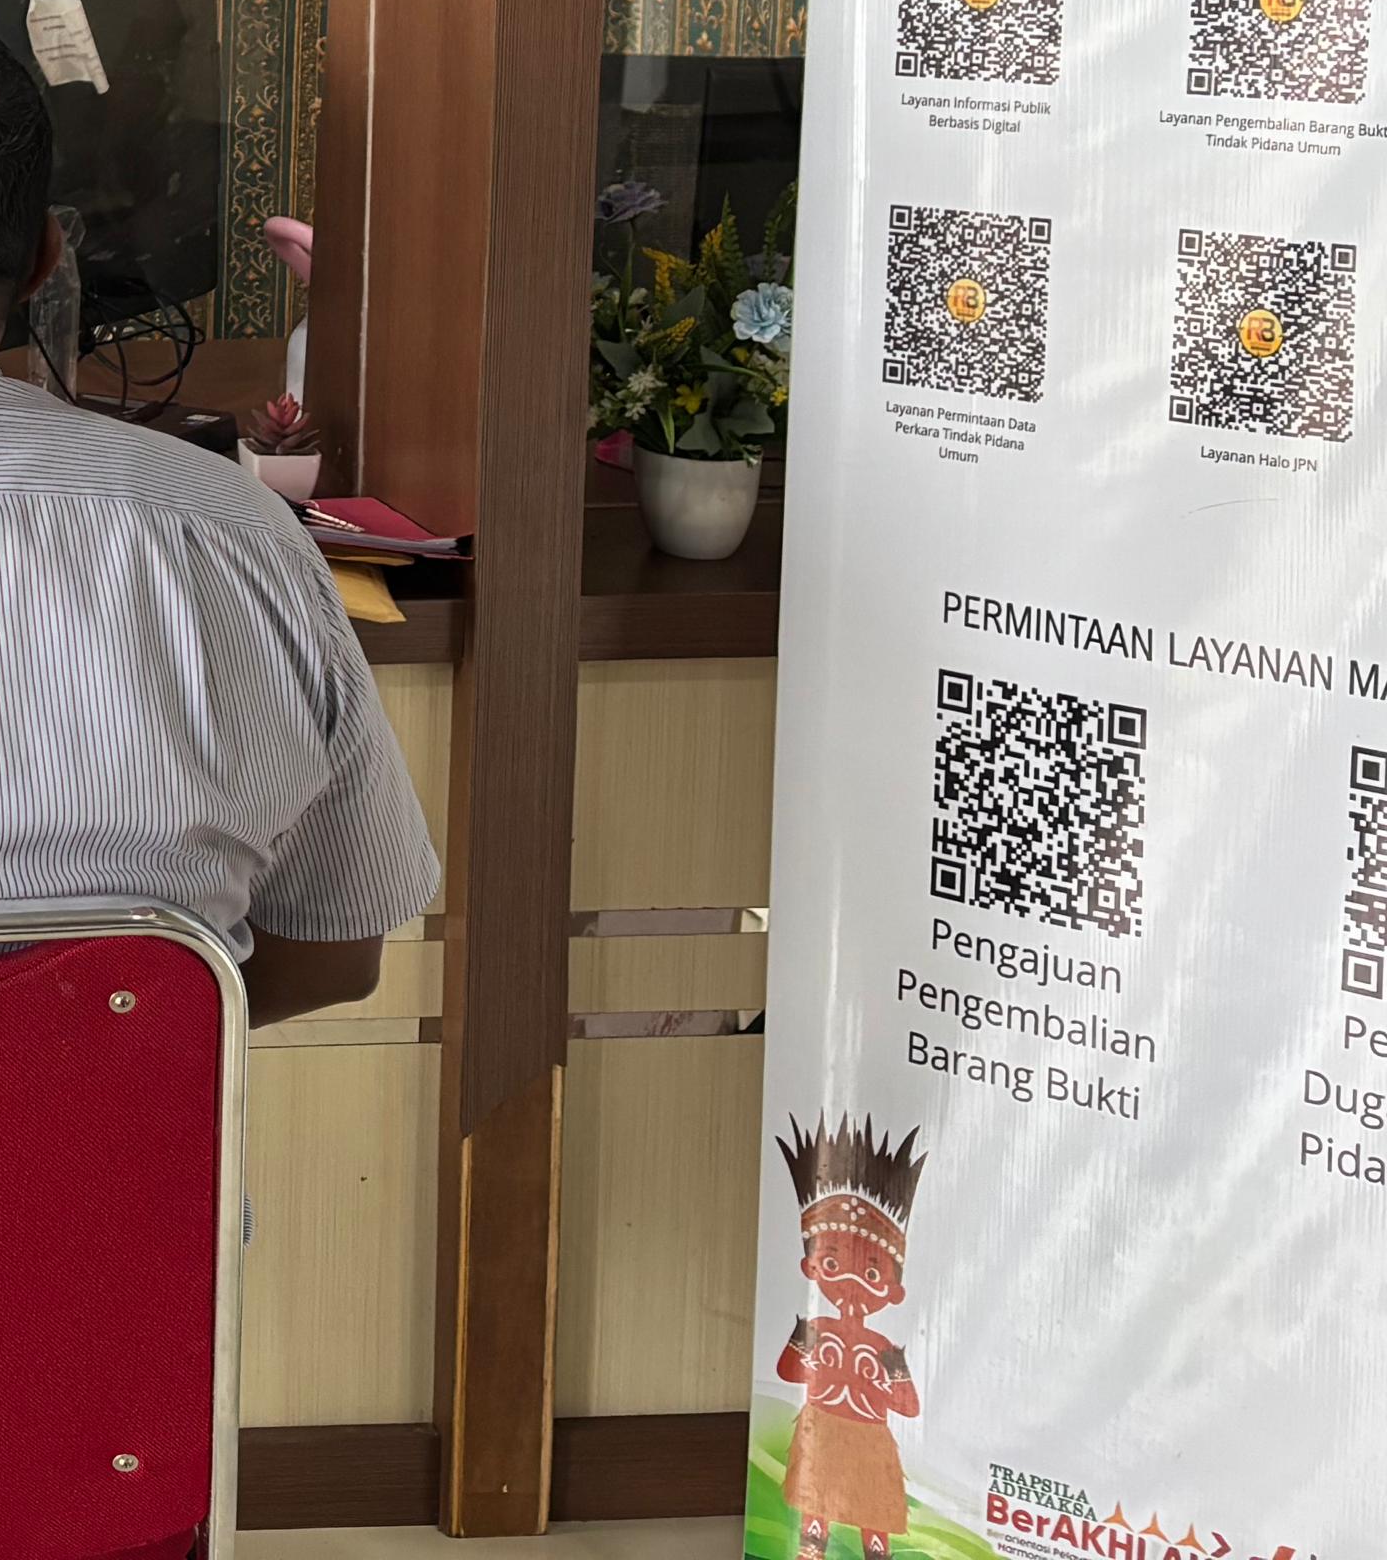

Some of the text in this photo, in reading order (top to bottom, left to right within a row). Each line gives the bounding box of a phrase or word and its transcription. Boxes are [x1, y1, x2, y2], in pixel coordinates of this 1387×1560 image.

[901, 93, 1051, 115] Layanan Informasi Publik
[929, 114, 1020, 135] Berbasis Digital
[1159, 110, 1212, 126] Layanan
[1216, 114, 1305, 132] Pengembalian
[1309, 120, 1355, 139] Barang
[1206, 133, 1341, 156] Tindak Pidana Umum
[886, 400, 1036, 433] Layanan Permintaan Data
[895, 421, 1025, 451] Perkara Tindak Pidana
[939, 446, 979, 464] Umum
[1200, 445, 1317, 472] Layanan Halo JPN
[943, 590, 1154, 662] PERMINTAAN
[1169, 631, 1333, 691] LAYANAN
[932, 918, 1123, 994] Pengajuan
[897, 968, 1157, 1063] Pengembalian
[907, 1031, 1141, 1121] Barang Bukti
[989, 1463, 1090, 1505] TRAPSILA
[988, 1479, 1099, 1522] ADHYAKSA
